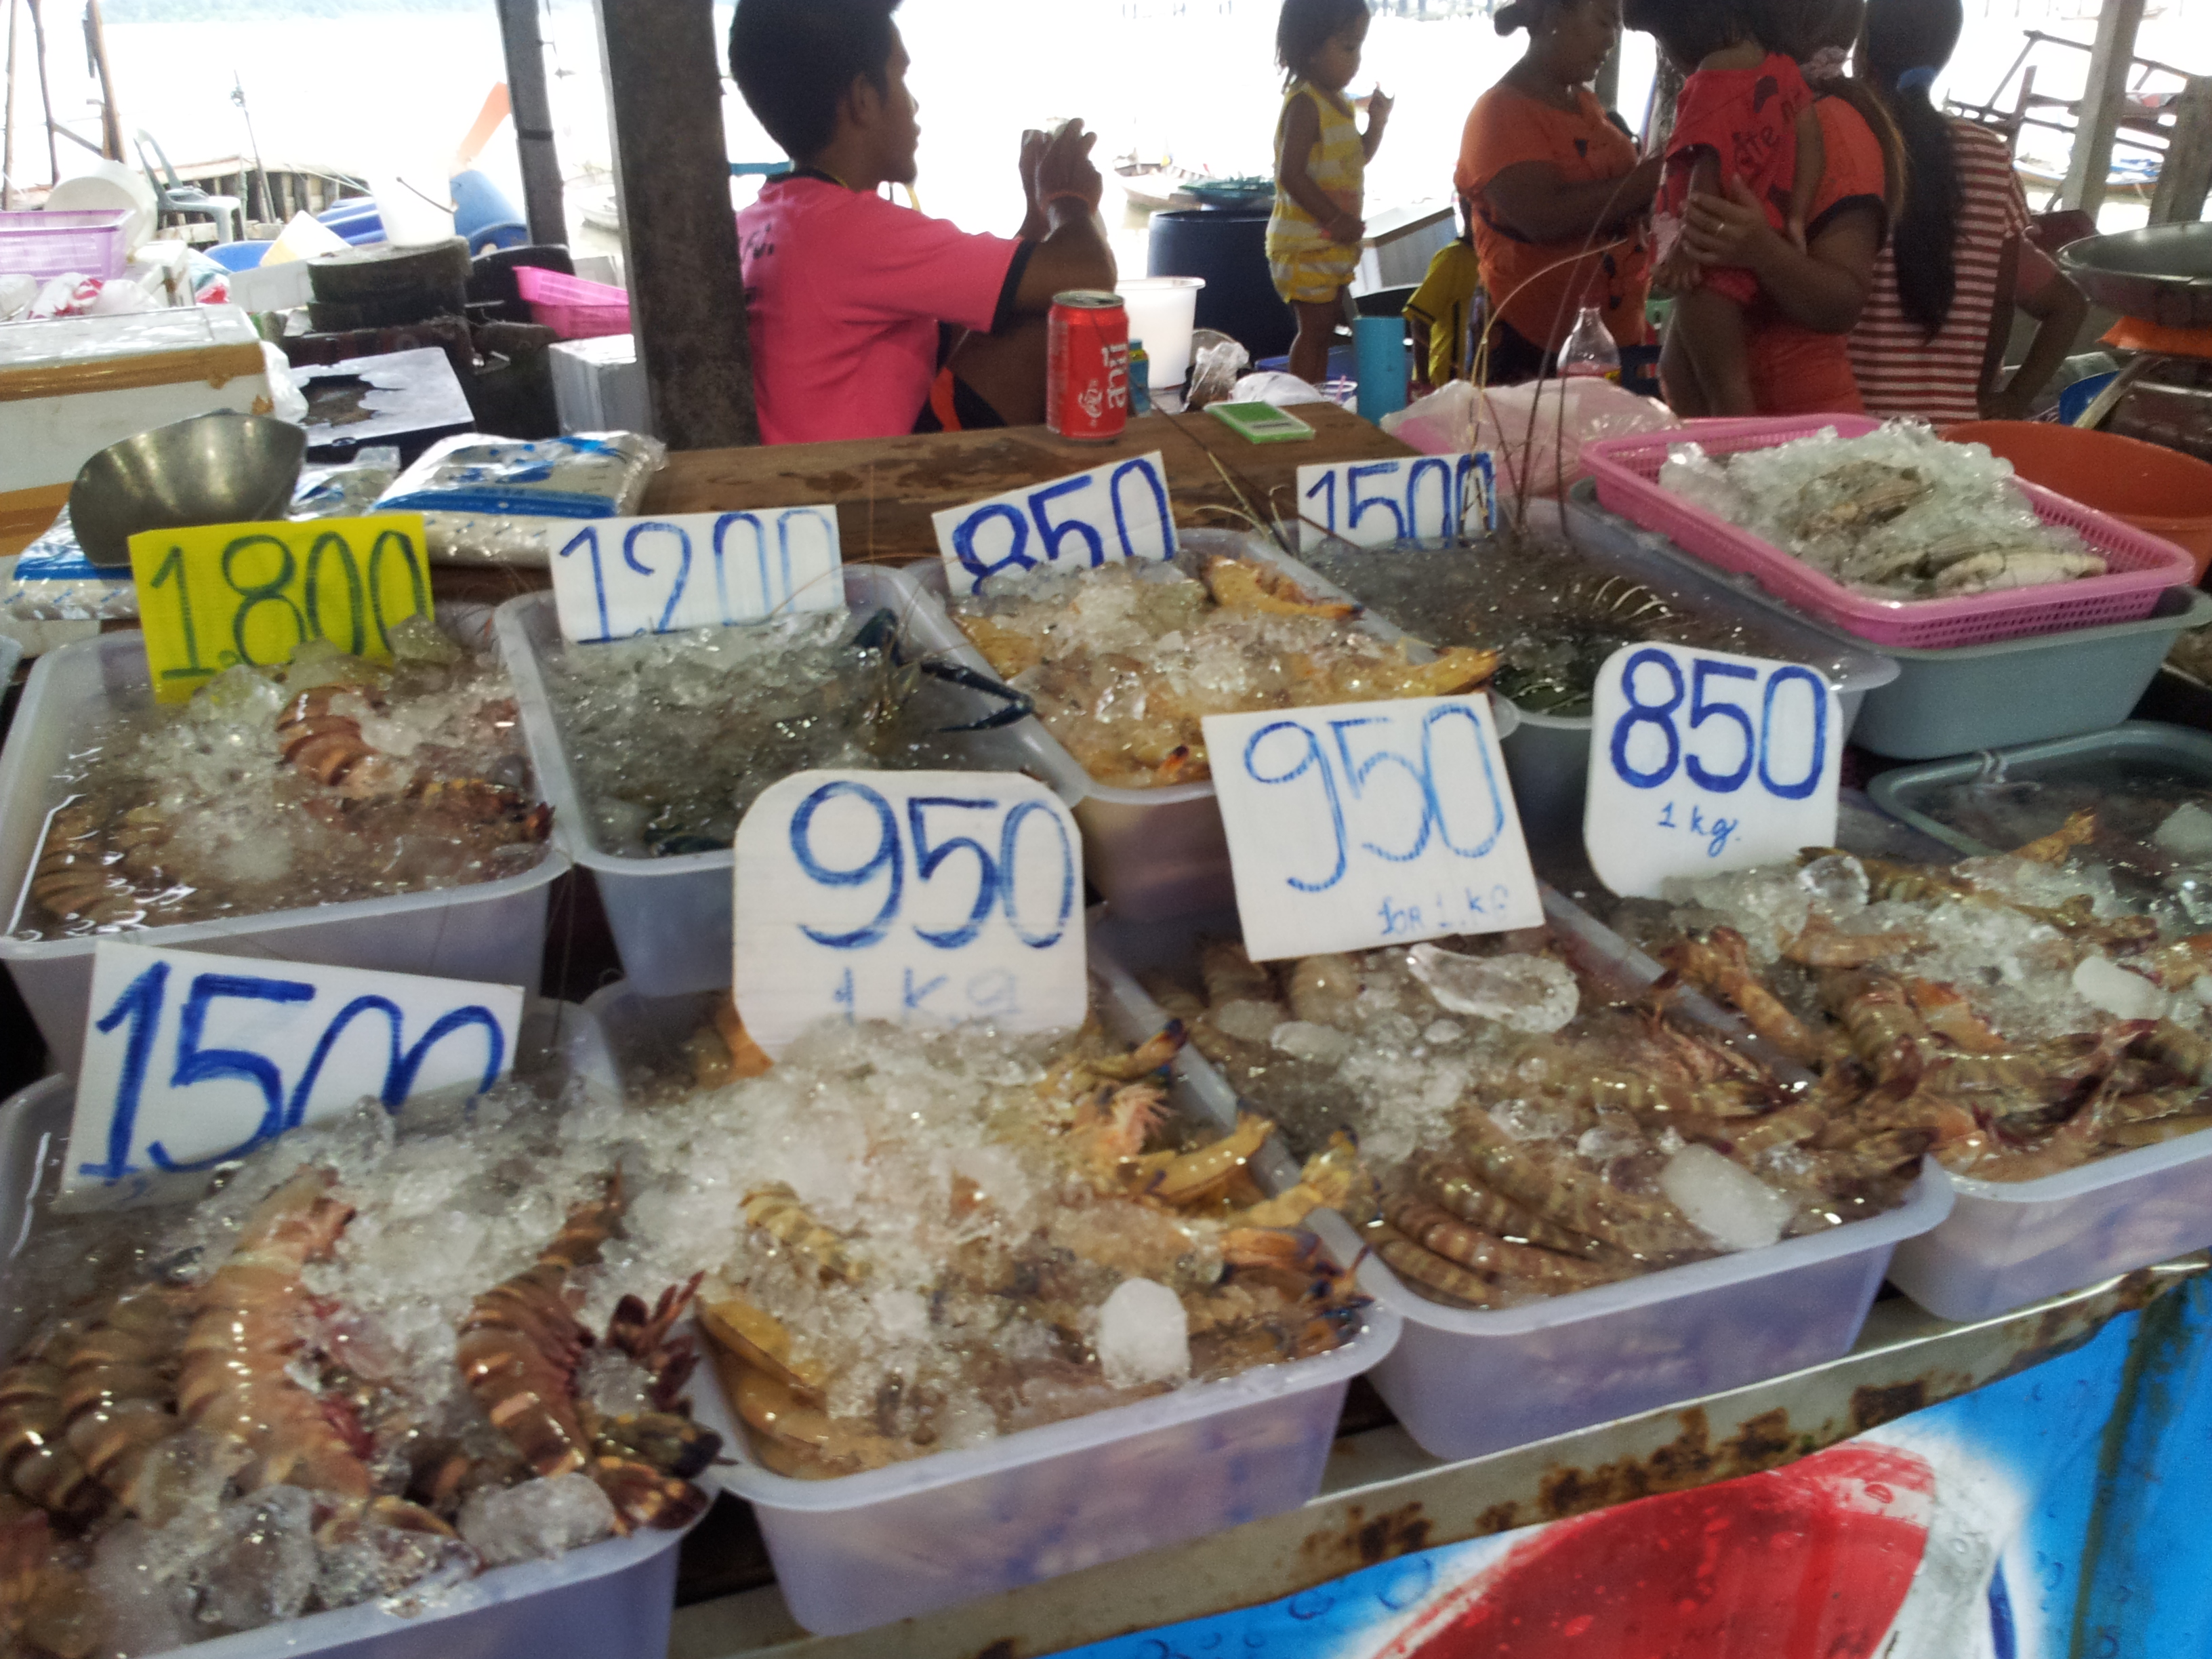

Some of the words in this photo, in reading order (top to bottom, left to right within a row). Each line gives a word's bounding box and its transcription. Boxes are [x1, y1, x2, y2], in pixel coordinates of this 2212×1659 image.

[1244, 703, 1504, 893] 950
[1610, 648, 1828, 800] 850
[789, 780, 1075, 949] 950
[1657, 801, 1677, 828] 1
